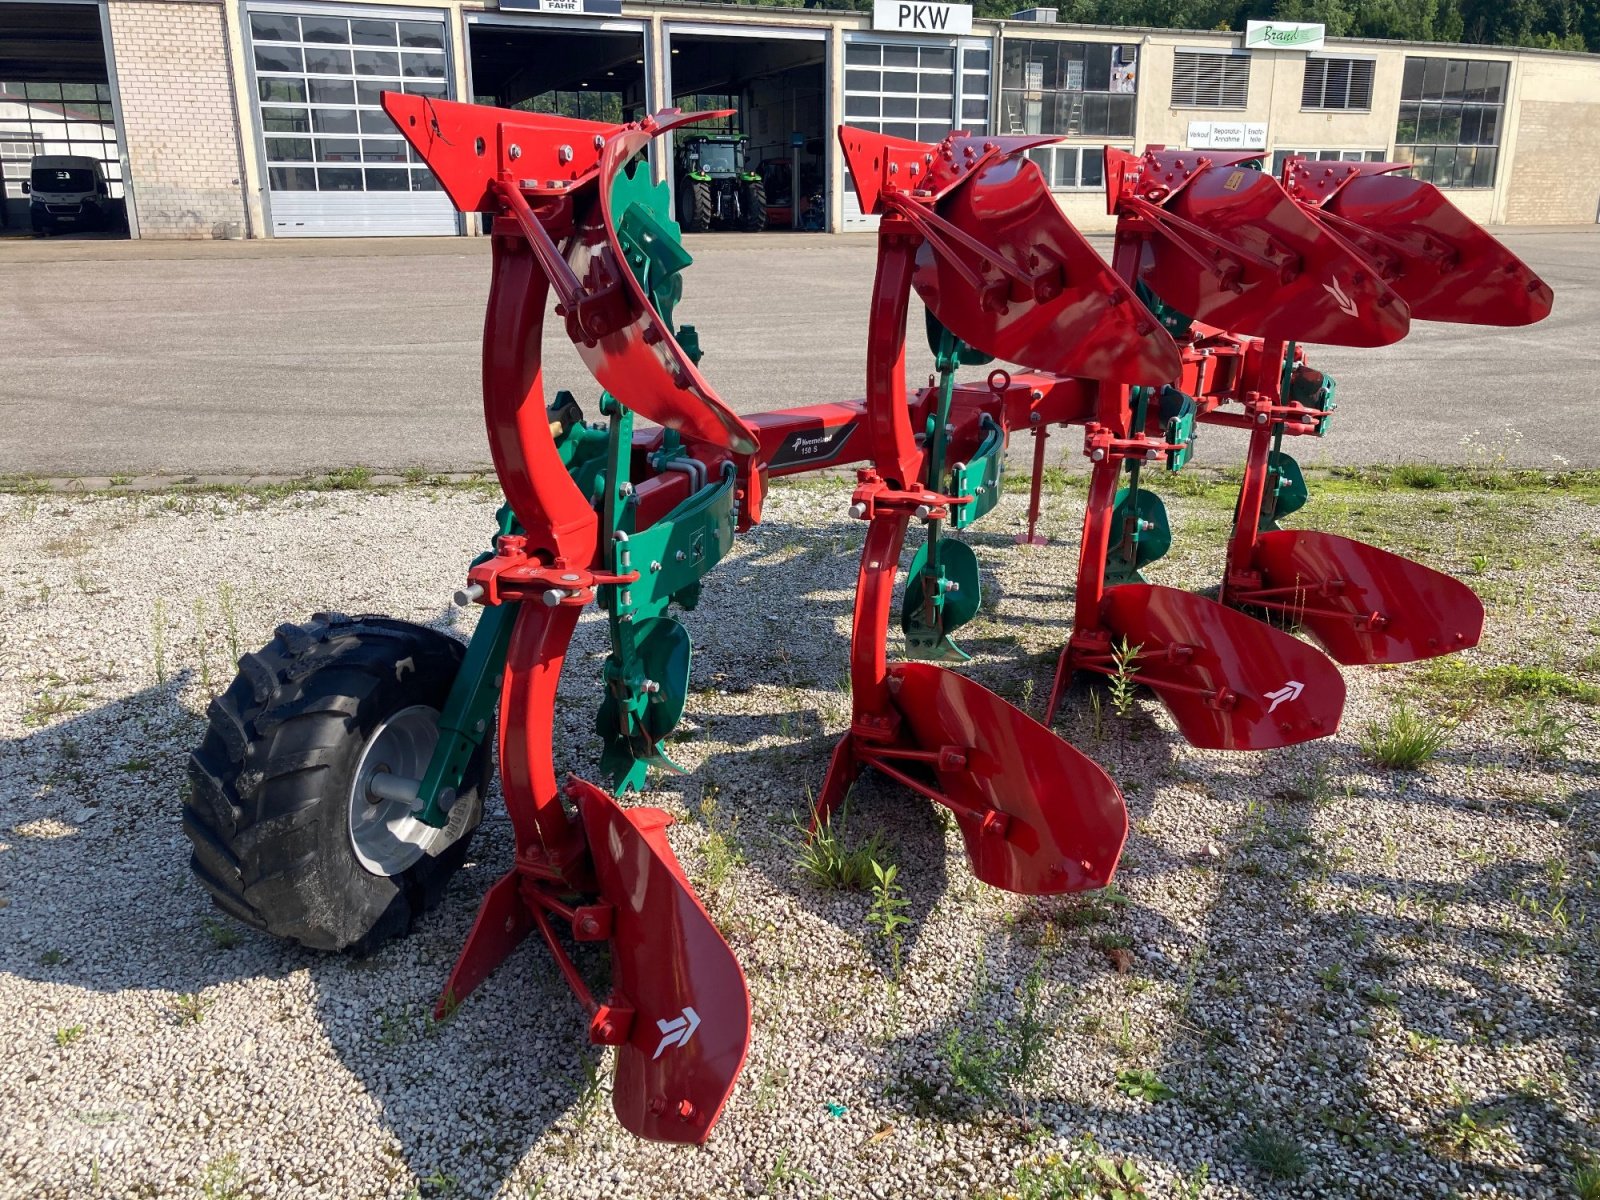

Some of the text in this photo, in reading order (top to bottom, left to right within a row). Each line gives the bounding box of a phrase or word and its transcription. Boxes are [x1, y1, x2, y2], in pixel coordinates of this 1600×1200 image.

[549, 2, 575, 10] FAHR
[899, 4, 950, 30] PKW
[1264, 25, 1299, 41] Brand
[801, 445, 818, 455] 150 S
